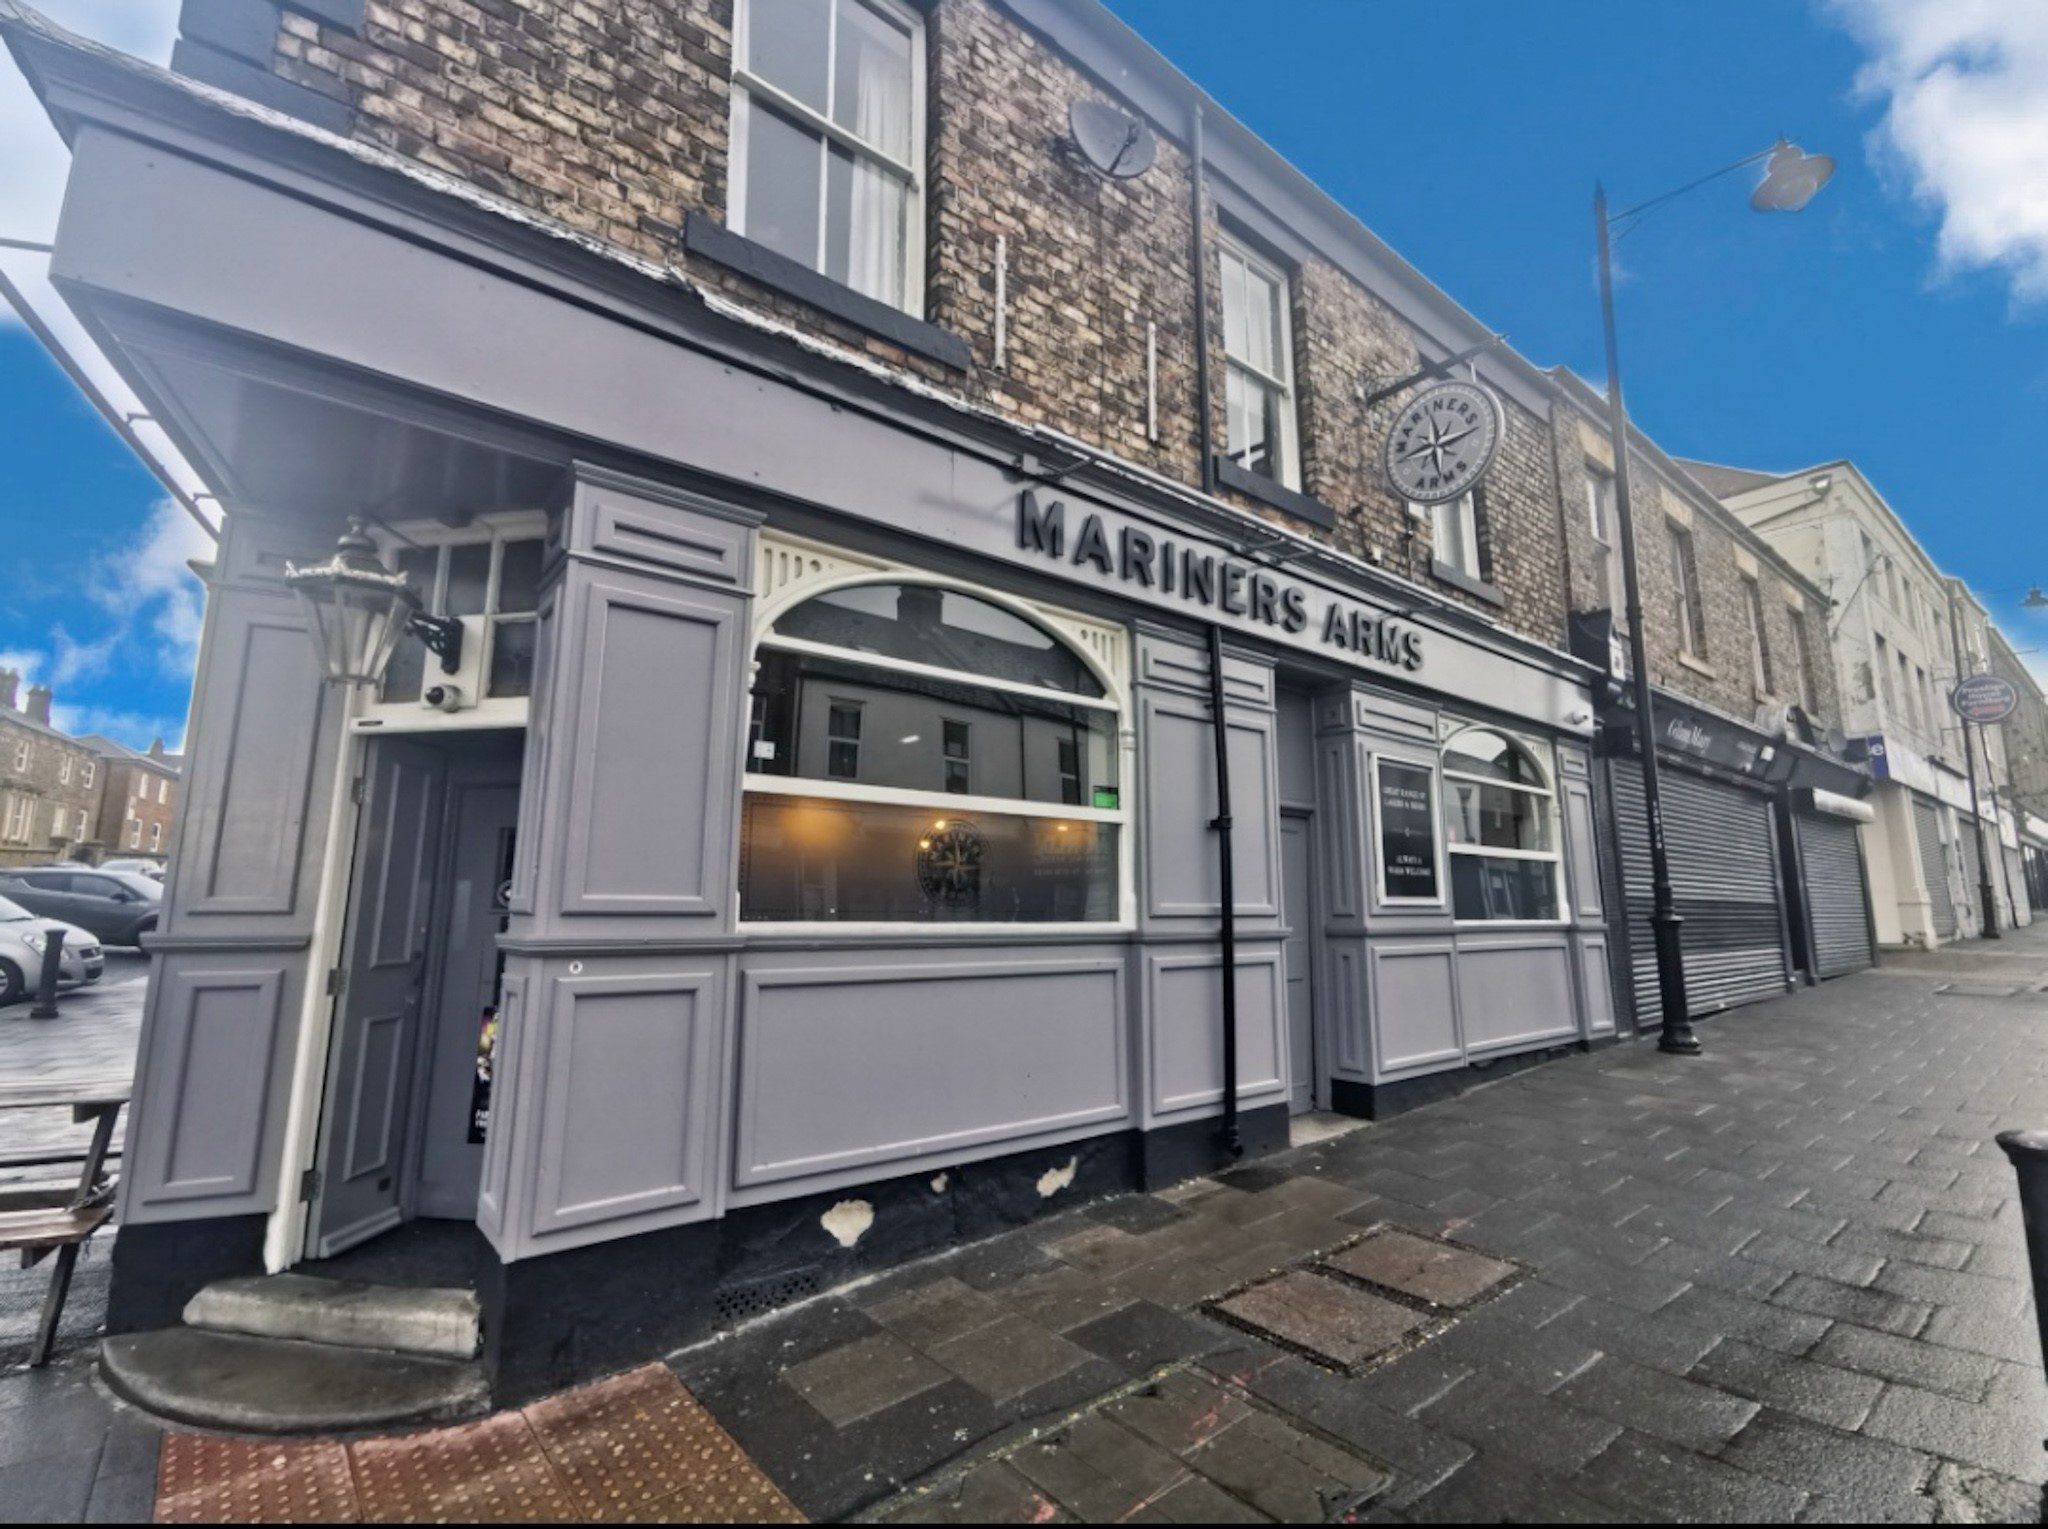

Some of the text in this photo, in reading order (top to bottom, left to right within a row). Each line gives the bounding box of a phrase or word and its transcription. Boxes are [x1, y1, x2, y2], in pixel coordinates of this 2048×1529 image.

[1396, 398, 1478, 453] MARINERS
[1415, 460, 1467, 489] ARMS
[1016, 489, 1425, 671] MARINERS ARMS
